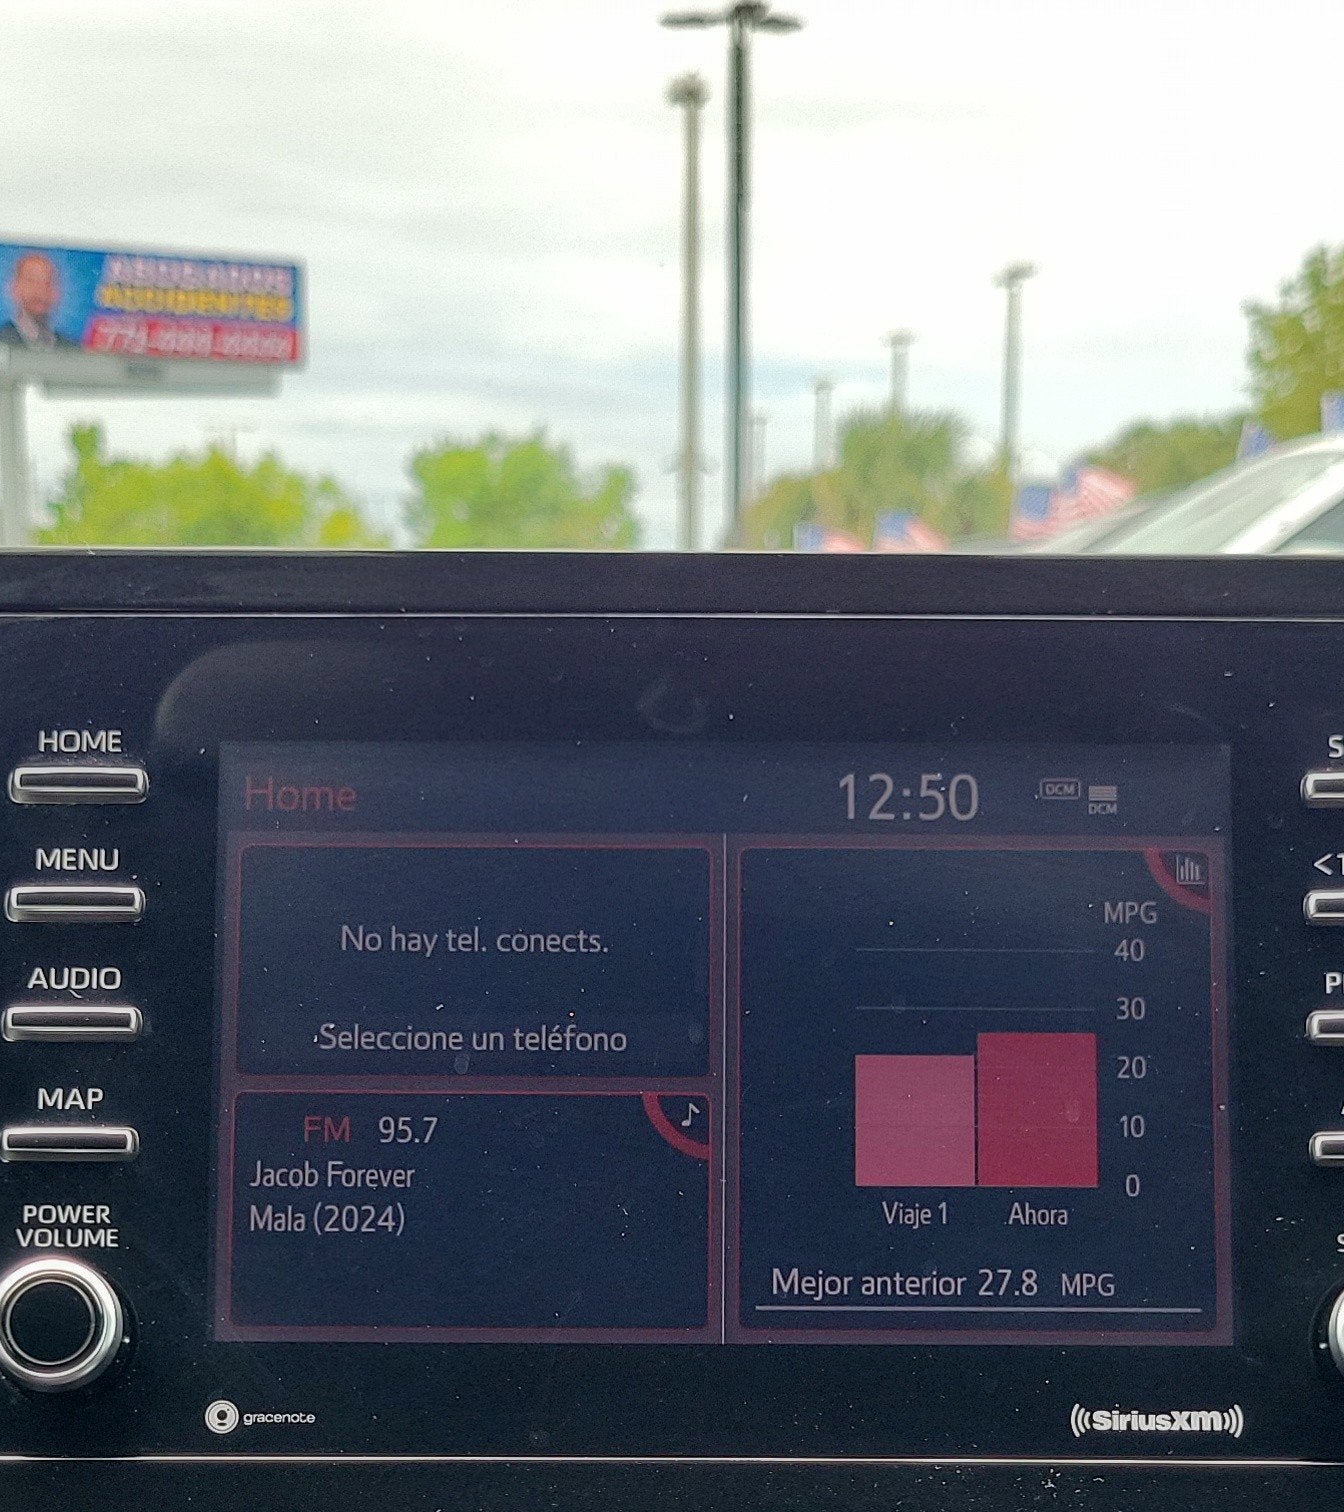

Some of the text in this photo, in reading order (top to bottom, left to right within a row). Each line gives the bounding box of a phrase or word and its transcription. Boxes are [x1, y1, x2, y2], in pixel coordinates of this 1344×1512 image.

[38, 730, 122, 753] HOME
[244, 777, 357, 812] Home
[838, 772, 979, 821] 12:50
[35, 848, 119, 871] MENU
[1103, 901, 1157, 924] MPG
[340, 924, 609, 957] No hay tel. conects.
[1113, 938, 1146, 962] 40
[27, 967, 122, 990] AUDIO
[1115, 996, 1146, 1021] 30
[319, 1023, 627, 1052] Seleccione un teléfono
[1116, 1056, 1147, 1079] 20
[37, 1087, 104, 1110] MAP
[304, 1116, 439, 1145] FM 95.7
[1118, 1115, 1146, 1138] 10
[250, 1161, 415, 1188] Jacob Forever
[1125, 1175, 1140, 1198] 0
[22, 1204, 111, 1224] POWER
[250, 1202, 406, 1236] Mala (2024)
[882, 1201, 948, 1230] Viaje 1
[1008, 1202, 1068, 1226] Ahora
[15, 1228, 119, 1248] VOLUME
[772, 1268, 1115, 1302] Mejor anterior 27.8 MPG
[243, 1410, 316, 1426] gracenote
